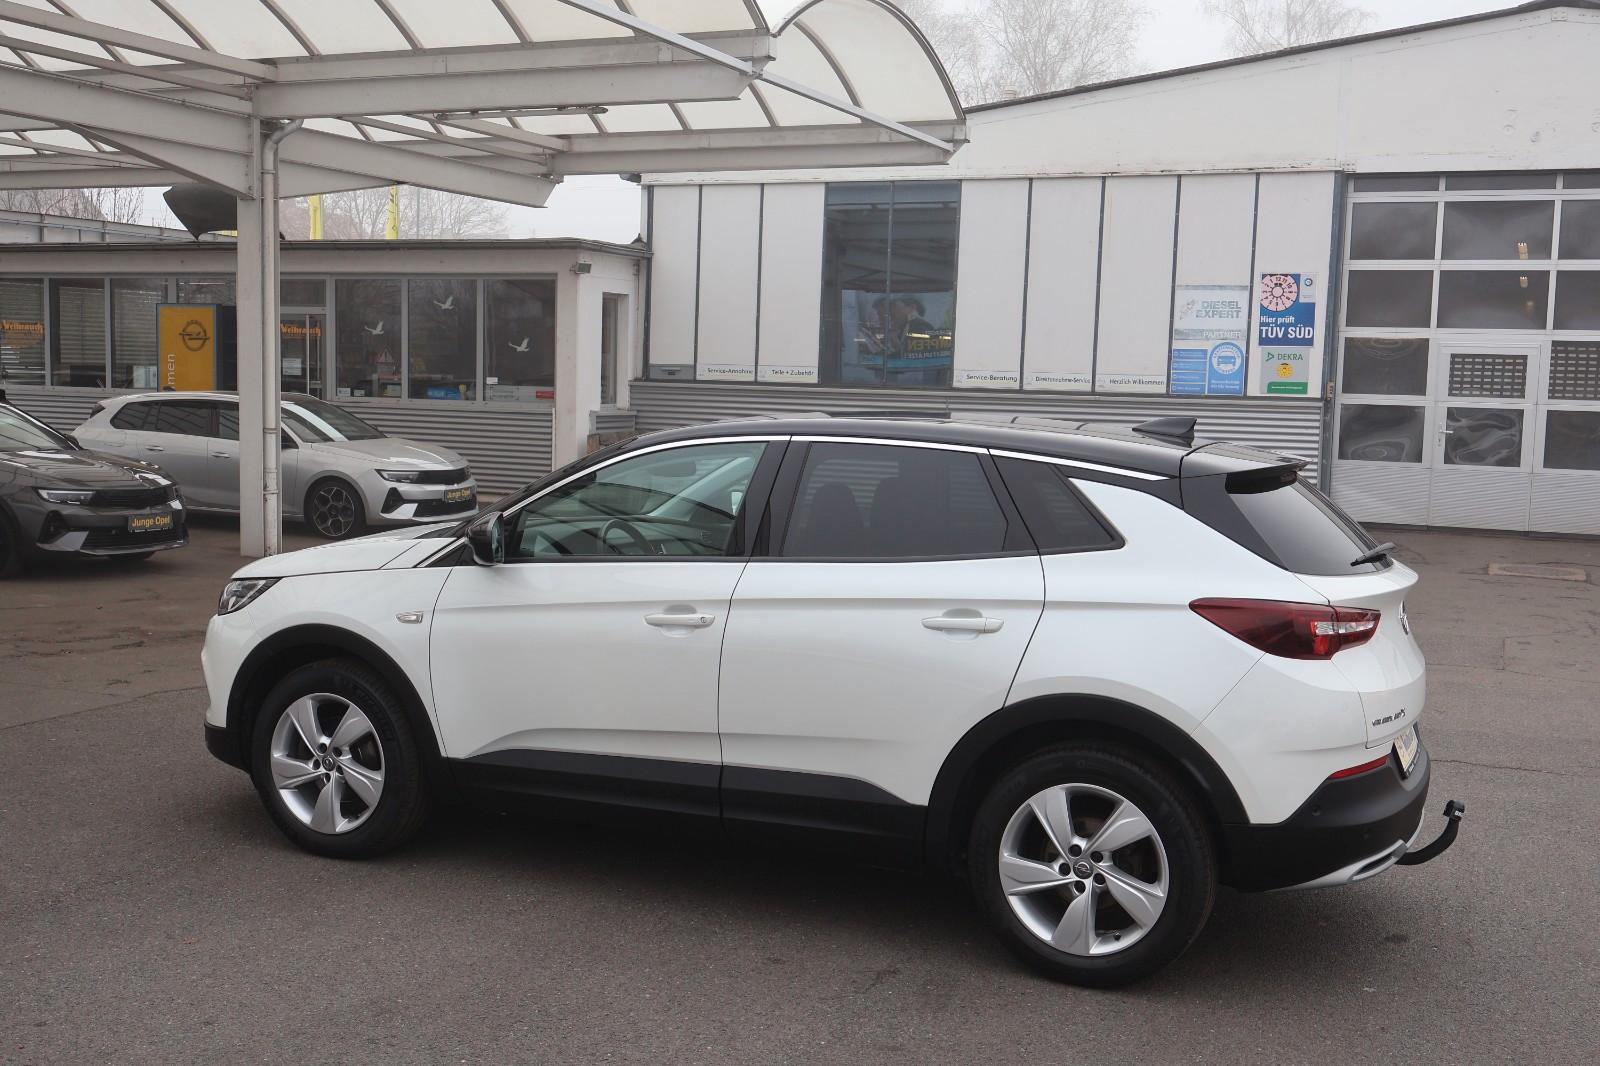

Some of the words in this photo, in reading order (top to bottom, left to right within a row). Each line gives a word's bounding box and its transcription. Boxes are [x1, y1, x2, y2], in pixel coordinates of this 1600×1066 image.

[1201, 300, 1242, 309] DIESEL
[1195, 309, 1242, 319] EXPERT
[1260, 315, 1276, 323] Hier
[1277, 315, 1295, 325] prüft
[1260, 324, 1285, 338] TÜV
[1287, 324, 1314, 339] SÜD
[1277, 353, 1304, 361] DEKRA
[966, 373, 1018, 383] Service-Beratung
[132, 518, 154, 528] Junge
[155, 515, 170, 526] Opel
